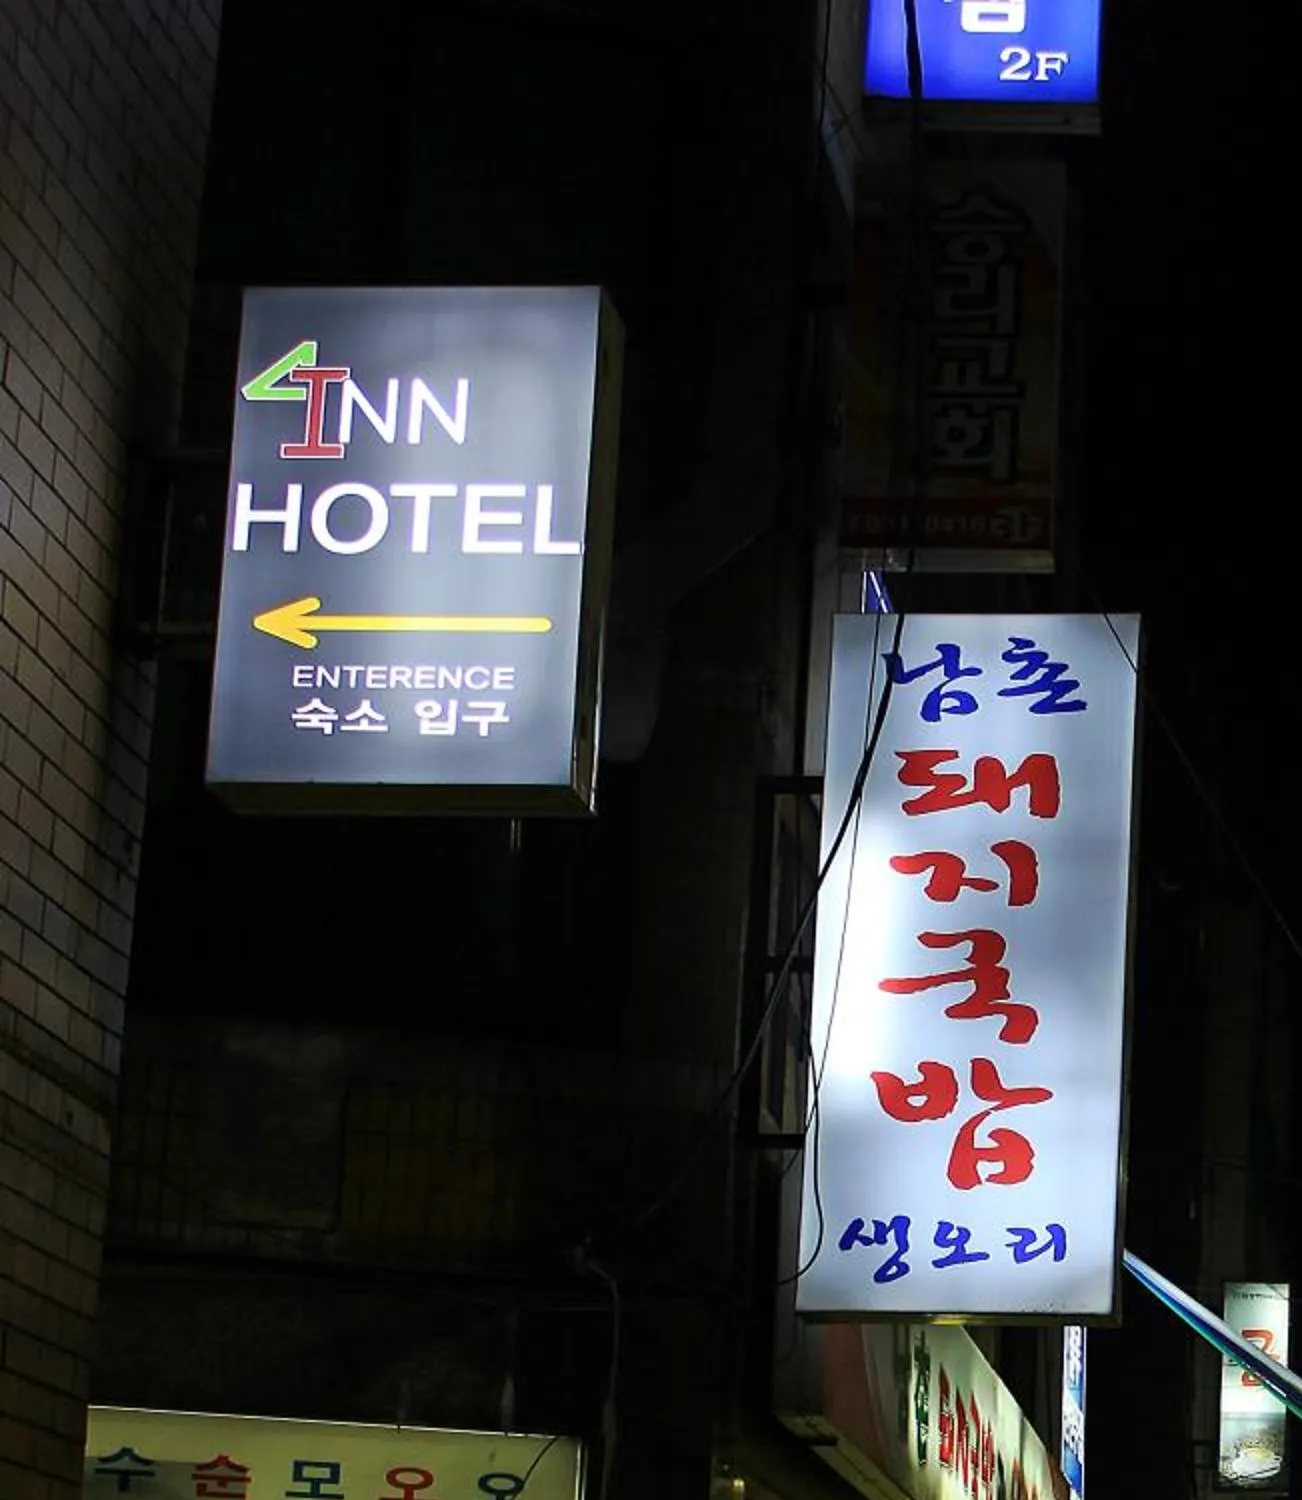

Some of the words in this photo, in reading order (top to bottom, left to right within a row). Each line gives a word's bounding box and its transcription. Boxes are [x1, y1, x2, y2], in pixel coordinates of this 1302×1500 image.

[999, 46, 1069, 81] 2F
[231, 482, 584, 555] HOTEL
[292, 664, 516, 690] ENTERENCE
[291, 698, 389, 735] 숙소
[413, 699, 510, 737] 입구
[871, 749, 1061, 1190] 돼지국밥
[838, 1215, 1068, 1284] 생오리
